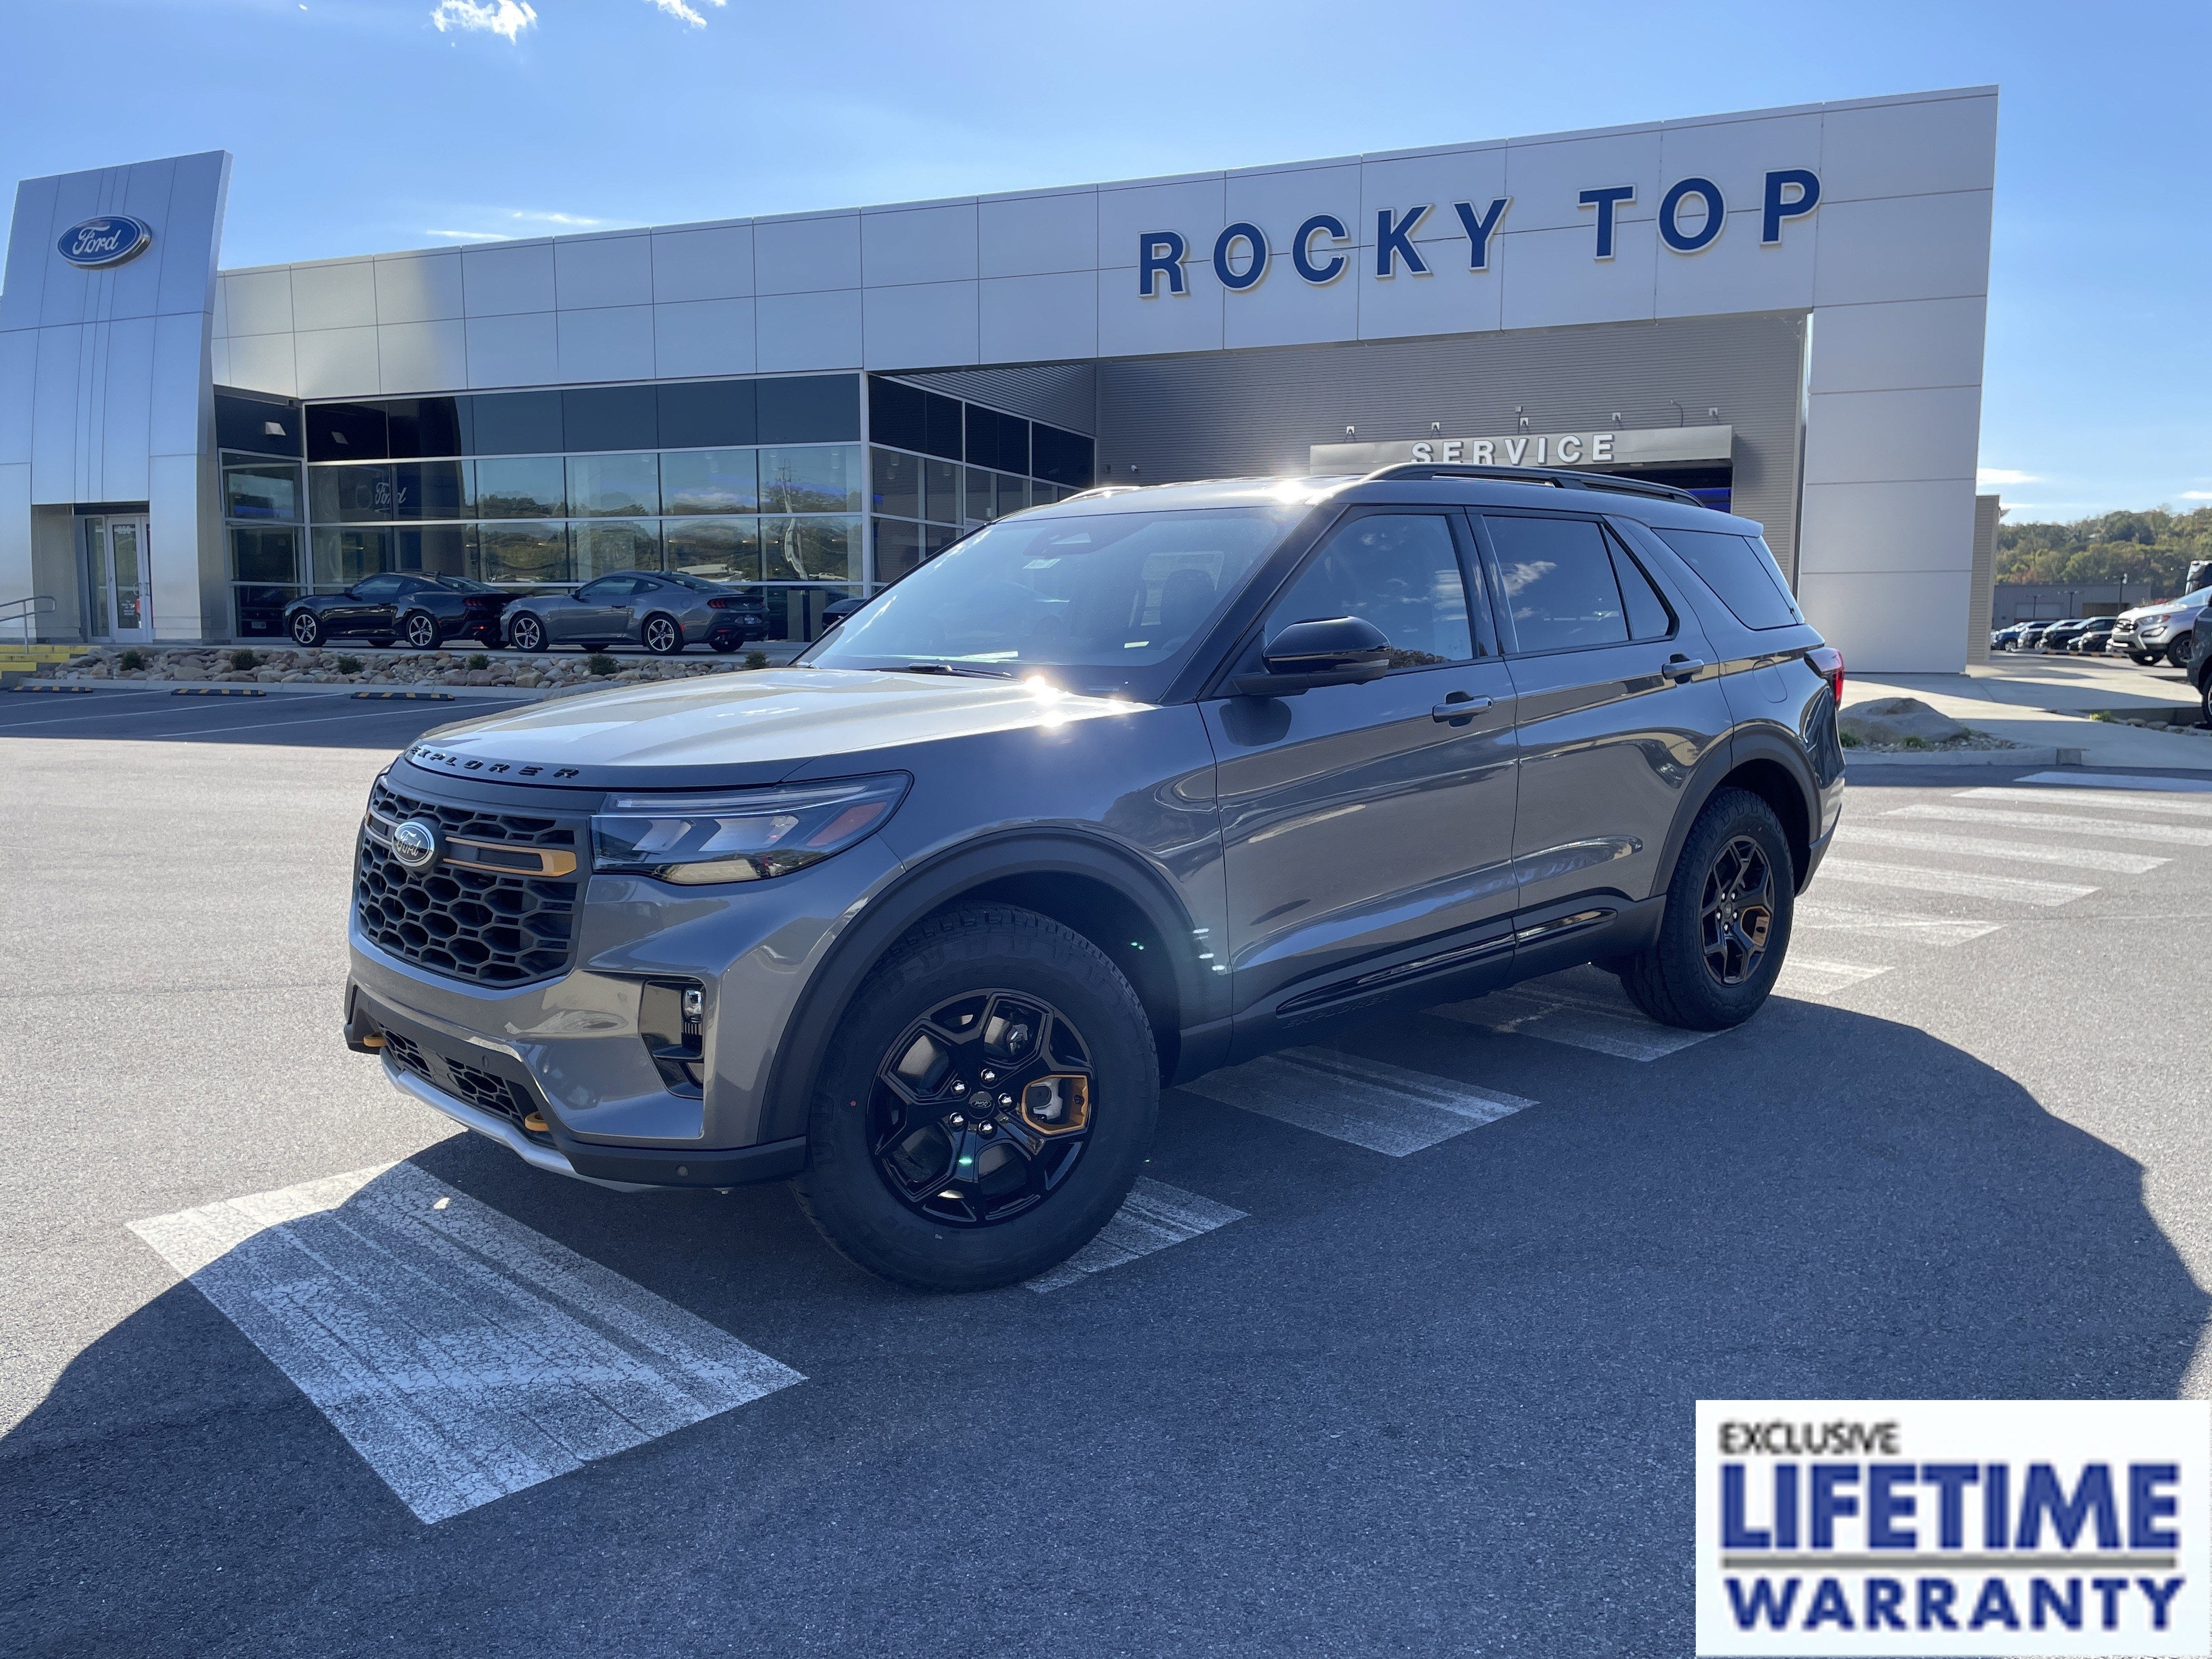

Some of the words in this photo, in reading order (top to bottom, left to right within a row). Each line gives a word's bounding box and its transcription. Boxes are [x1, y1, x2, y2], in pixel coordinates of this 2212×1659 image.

[72, 225, 121, 255] Ford
[1138, 196, 1512, 297] ROCKY
[1577, 167, 1821, 260] TOP
[1410, 434, 1614, 466] SERVICE
[410, 746, 579, 779] EXPLORER
[397, 830, 421, 856] Ford
